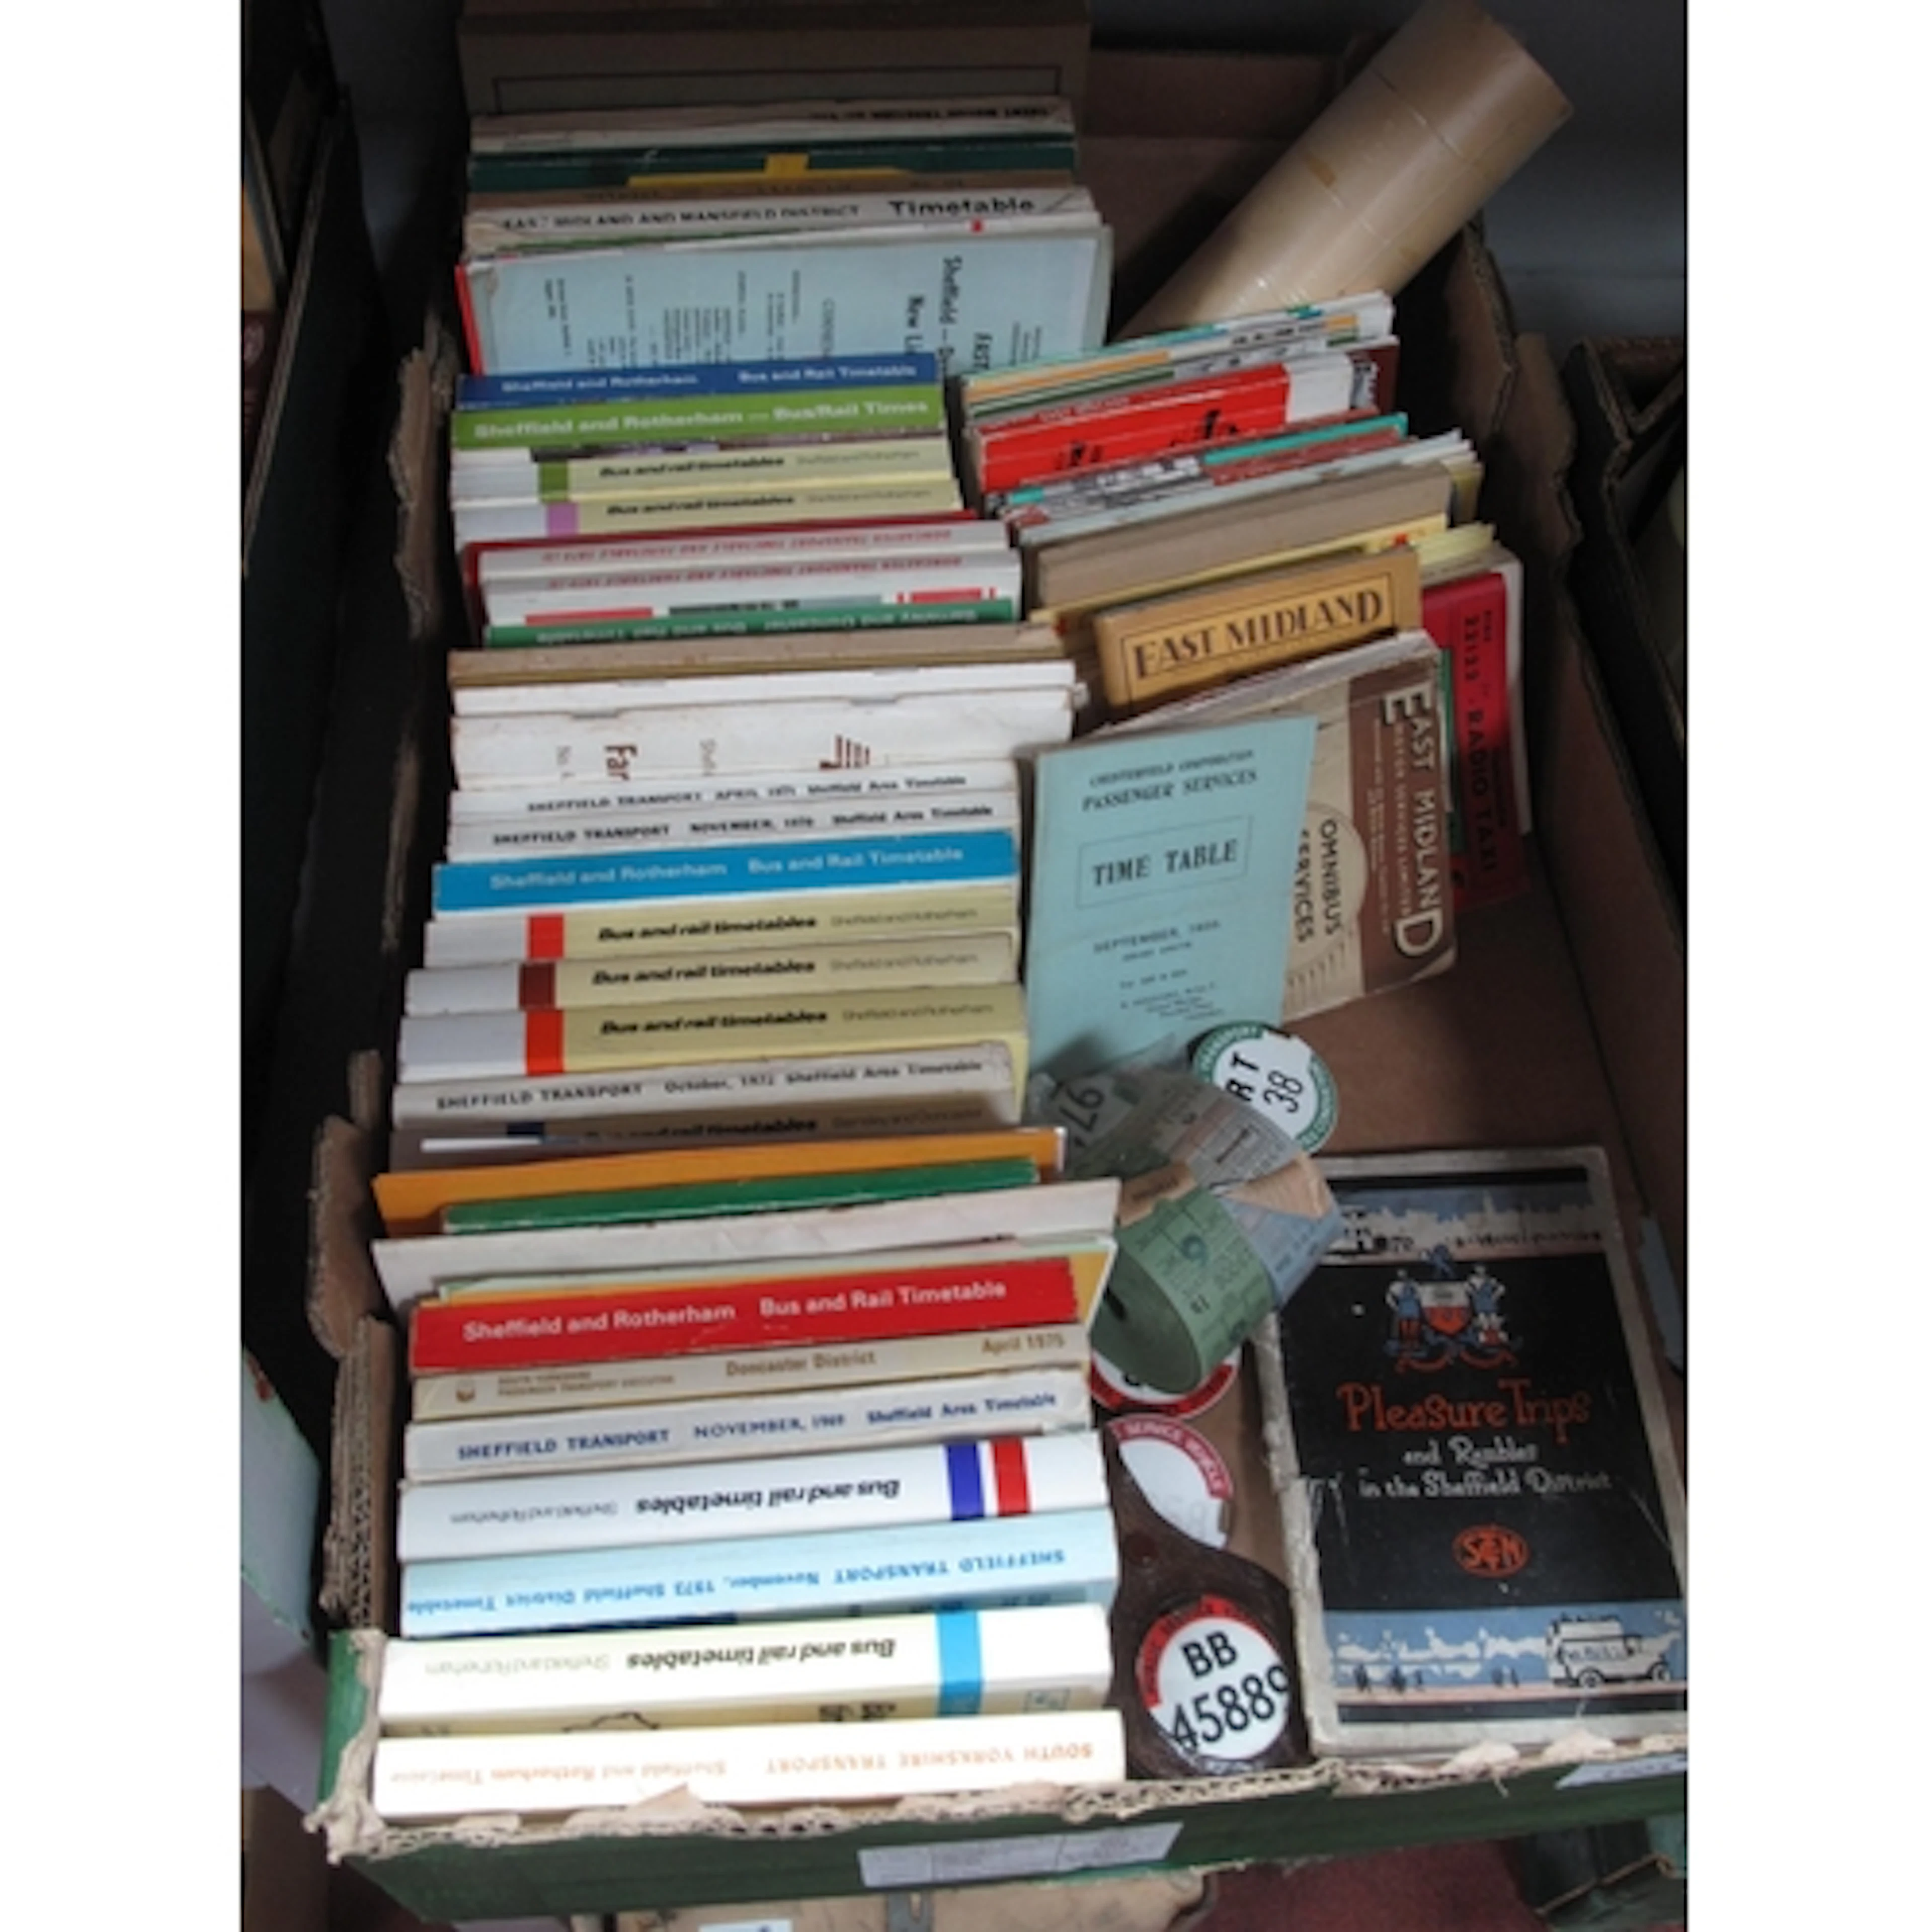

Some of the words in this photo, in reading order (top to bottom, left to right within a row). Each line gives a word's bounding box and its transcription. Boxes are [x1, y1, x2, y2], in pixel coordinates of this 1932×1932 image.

[889, 196, 1035, 215] Timetable
[940, 255, 963, 326] Sheffield
[502, 379, 574, 392] Sheffield
[577, 376, 607, 389] and
[610, 373, 699, 387] Rotherham
[738, 369, 768, 384] Bus
[771, 368, 800, 381] and
[803, 365, 836, 380] Rail
[839, 363, 917, 378] Timetable
[474, 420, 573, 439] Sheffield
[578, 416, 619, 433] and
[622, 411, 744, 430] Rotherham
[862, 400, 929, 416] Times
[600, 467, 630, 476] Bus
[634, 463, 666, 474] and
[667, 461, 694, 471] rail
[698, 455, 784, 469] timetables
[606, 505, 638, 515] Bus
[642, 501, 674, 512] and
[675, 499, 703, 509] rail
[706, 495, 794, 509] timetables
[1133, 626, 1220, 679] EAST
[1225, 586, 1384, 650] MIDLAND
[1383, 682, 1436, 772] EAST
[605, 744, 637, 780] Far
[1467, 708, 1490, 796] RADIO
[1089, 762, 1174, 788] CHESTERFIELD
[528, 797, 611, 812] SHEFFIELD
[617, 791, 702, 805] TRANSPORT
[808, 781, 862, 795] Sheffield
[868, 780, 899, 790] Area
[904, 776, 966, 788] Timetable
[1081, 781, 1174, 812] PASSENGER
[1182, 768, 1258, 795] SERVICES
[493, 832, 576, 845] SHEFFIELD
[584, 824, 670, 840] TRANSPORT
[831, 813, 887, 826] Sheffield
[894, 810, 924, 822] Area
[930, 805, 994, 819] Timetable
[1474, 807, 1498, 873] TAXI
[490, 870, 576, 891] Sheffield
[579, 867, 616, 884] and
[620, 861, 728, 881] Rotherham
[747, 857, 783, 874] Bus
[787, 855, 824, 871] and
[826, 851, 864, 868] Rail
[867, 847, 964, 867] Timetable
[1093, 853, 1152, 887] TIME
[1164, 838, 1238, 874] TABLE
[1394, 790, 1443, 957] MIDLAND
[1320, 820, 1343, 935] OMNIBUS
[599, 926, 637, 941] Bus
[640, 922, 677, 939] and
[679, 920, 710, 936] rail
[714, 915, 817, 934] timetables
[592, 970, 630, 985] Bus
[634, 967, 671, 983] and
[675, 964, 707, 979] rail
[711, 959, 815, 978] timetables
[600, 1020, 637, 1035] Bus
[643, 1016, 681, 1031] and
[684, 1013, 715, 1029] rail
[720, 1009, 827, 1028] timetables
[437, 1090, 533, 1109] SHEFFIELD
[540, 1082, 643, 1102] TRANSPORT
[786, 1068, 855, 1084] Sheffield
[862, 1066, 900, 1078] Area
[907, 1059, 983, 1075] Timetable
[1262, 1070, 1305, 1113] 38
[707, 1117, 817, 1135] timetables
[462, 1315, 562, 1342] Sheffield
[568, 1312, 607, 1332] and
[613, 1303, 736, 1329] Rotherham
[759, 1297, 801, 1317] Bus
[807, 1295, 847, 1313] and
[851, 1290, 894, 1310] Rail
[897, 1279, 1006, 1306] Timetable
[982, 1333, 1021, 1354] April
[726, 1354, 807, 1377] Doncaster
[813, 1349, 876, 1369] District
[1336, 1381, 1508, 1432] Pleasure
[1497, 1377, 1592, 1444] Trips
[458, 1439, 557, 1460] SHEFFIELD
[567, 1429, 670, 1451] TRANSPORT
[694, 1416, 807, 1439] NOVEMBER,
[866, 1405, 932, 1425] Sheffield
[940, 1402, 977, 1417] Area
[985, 1392, 1057, 1412] Timetable
[1403, 1439, 1441, 1466] and
[1448, 1435, 1539, 1469] Rambles
[808, 1483, 851, 1504] and
[857, 1480, 901, 1498] Bus
[1359, 1467, 1380, 1498] in
[1386, 1474, 1419, 1497] the
[1422, 1468, 1521, 1497] Sheffield
[635, 1488, 763, 1514] timetables
[767, 1487, 806, 1507] rail
[833, 1560, 950, 1584] TRANSPORT
[958, 1549, 1065, 1574] SHEFFIELD
[583, 1583, 665, 1604] Sheffield
[723, 1570, 820, 1591] November,
[408, 1596, 496, 1616] Timetable
[506, 1589, 575, 1608] District
[626, 1645, 754, 1671] timetables
[758, 1645, 797, 1665] rail
[800, 1641, 846, 1662] and
[854, 1638, 896, 1658] Bus
[1180, 1631, 1237, 1679] BB
[899, 1746, 1014, 1769] YORKSHIRE
[1024, 1742, 1093, 1760] SOUTH
[490, 1765, 596, 1783] Rotherham
[602, 1764, 635, 1781] and
[765, 1755, 887, 1775] TRANSPORT
